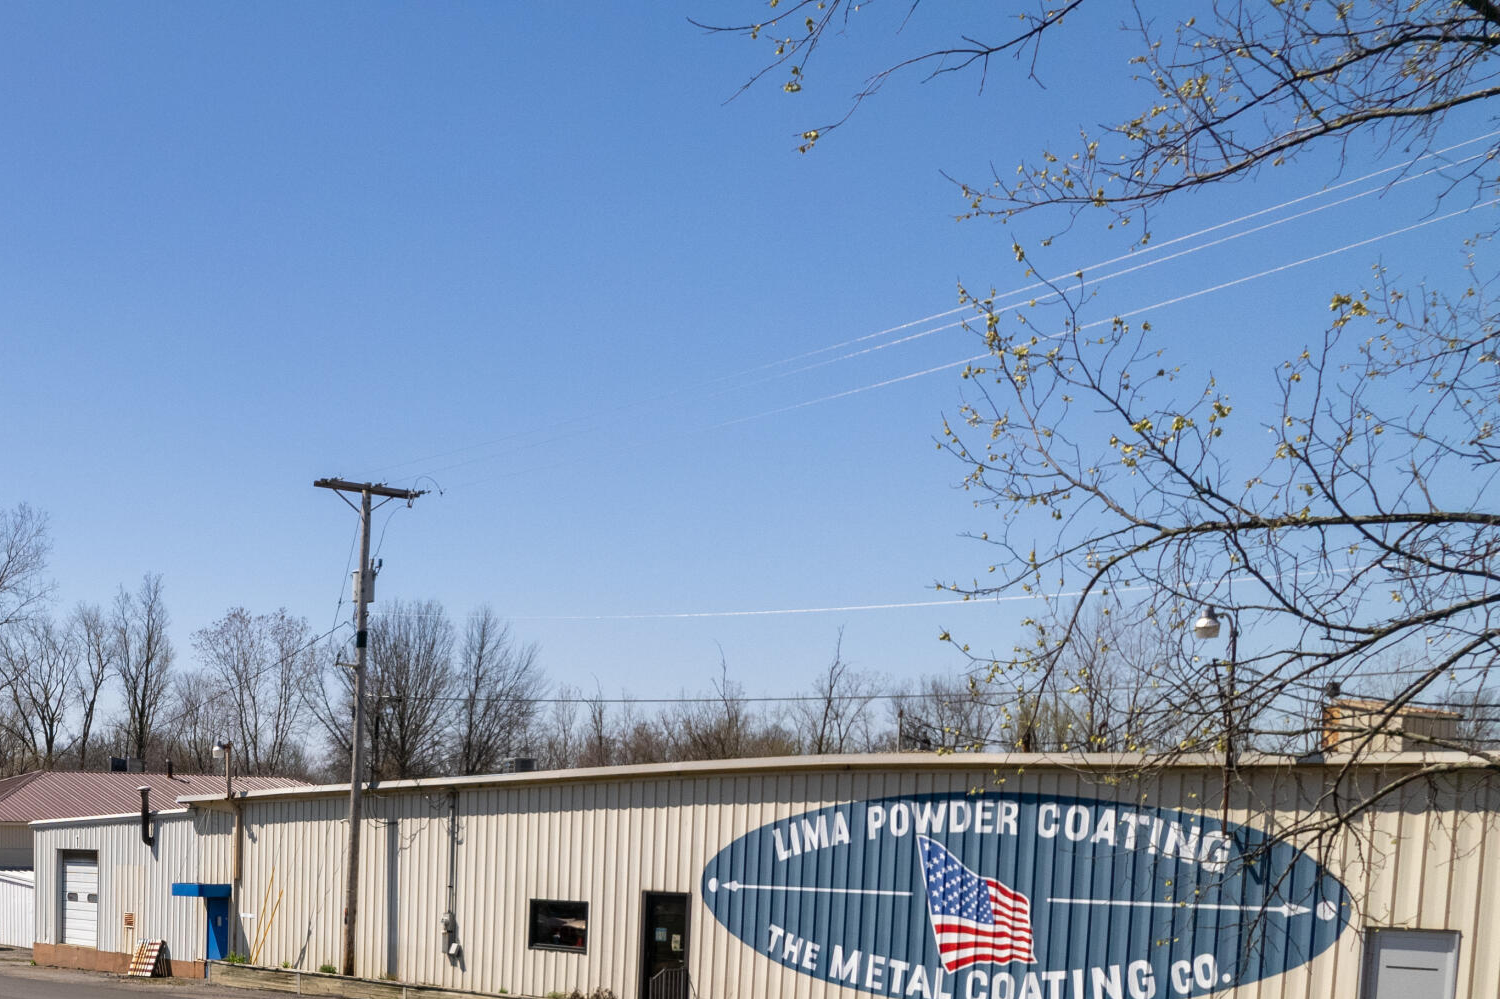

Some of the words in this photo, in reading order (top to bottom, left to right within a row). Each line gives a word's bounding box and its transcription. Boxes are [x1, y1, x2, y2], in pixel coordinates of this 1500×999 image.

[772, 811, 852, 862] LIMA
[867, 800, 1019, 841] POWDER
[1037, 803, 1232, 874] COATING
[767, 924, 821, 971] THE
[1171, 953, 1231, 995] CO.
